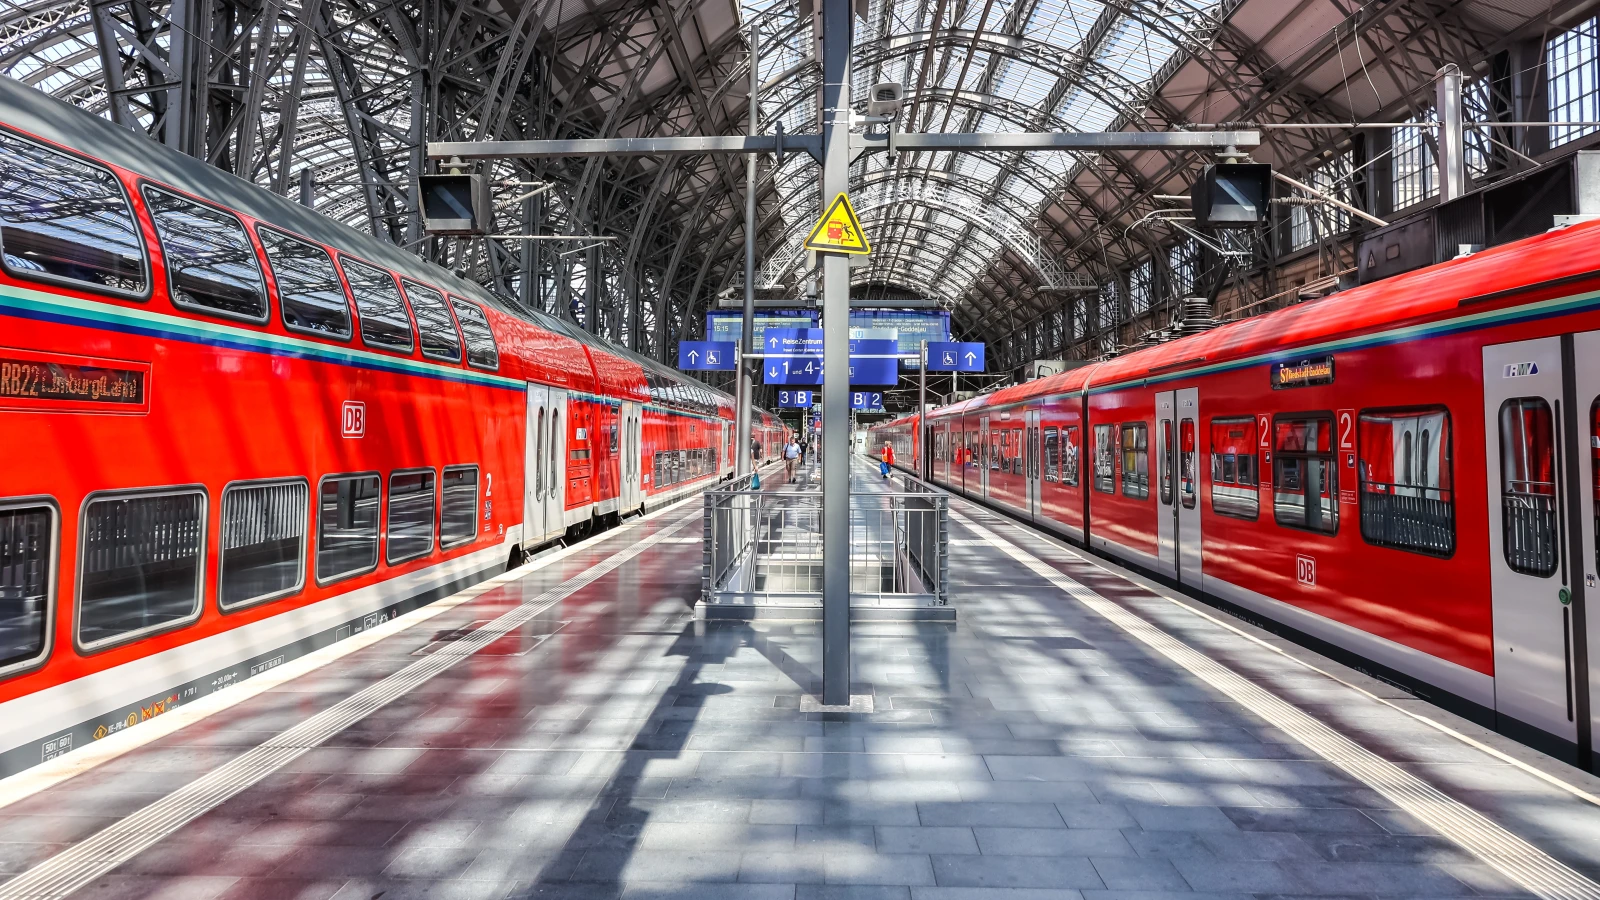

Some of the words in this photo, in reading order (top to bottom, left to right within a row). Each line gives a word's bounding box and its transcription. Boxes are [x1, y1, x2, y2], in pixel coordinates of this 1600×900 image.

[0, 362, 39, 397] RB22
[782, 361, 789, 375] 1
[1280, 367, 1289, 383] S7
[780, 391, 789, 404] 3
[797, 391, 807, 404] B
[853, 392, 863, 405] B
[871, 393, 880, 406] 2
[344, 406, 363, 433] DB
[1260, 416, 1269, 447] 2
[1340, 412, 1352, 448] 2
[1115, 424, 1120, 445] 2
[485, 472, 492, 497] 2
[1298, 558, 1315, 584] DB
